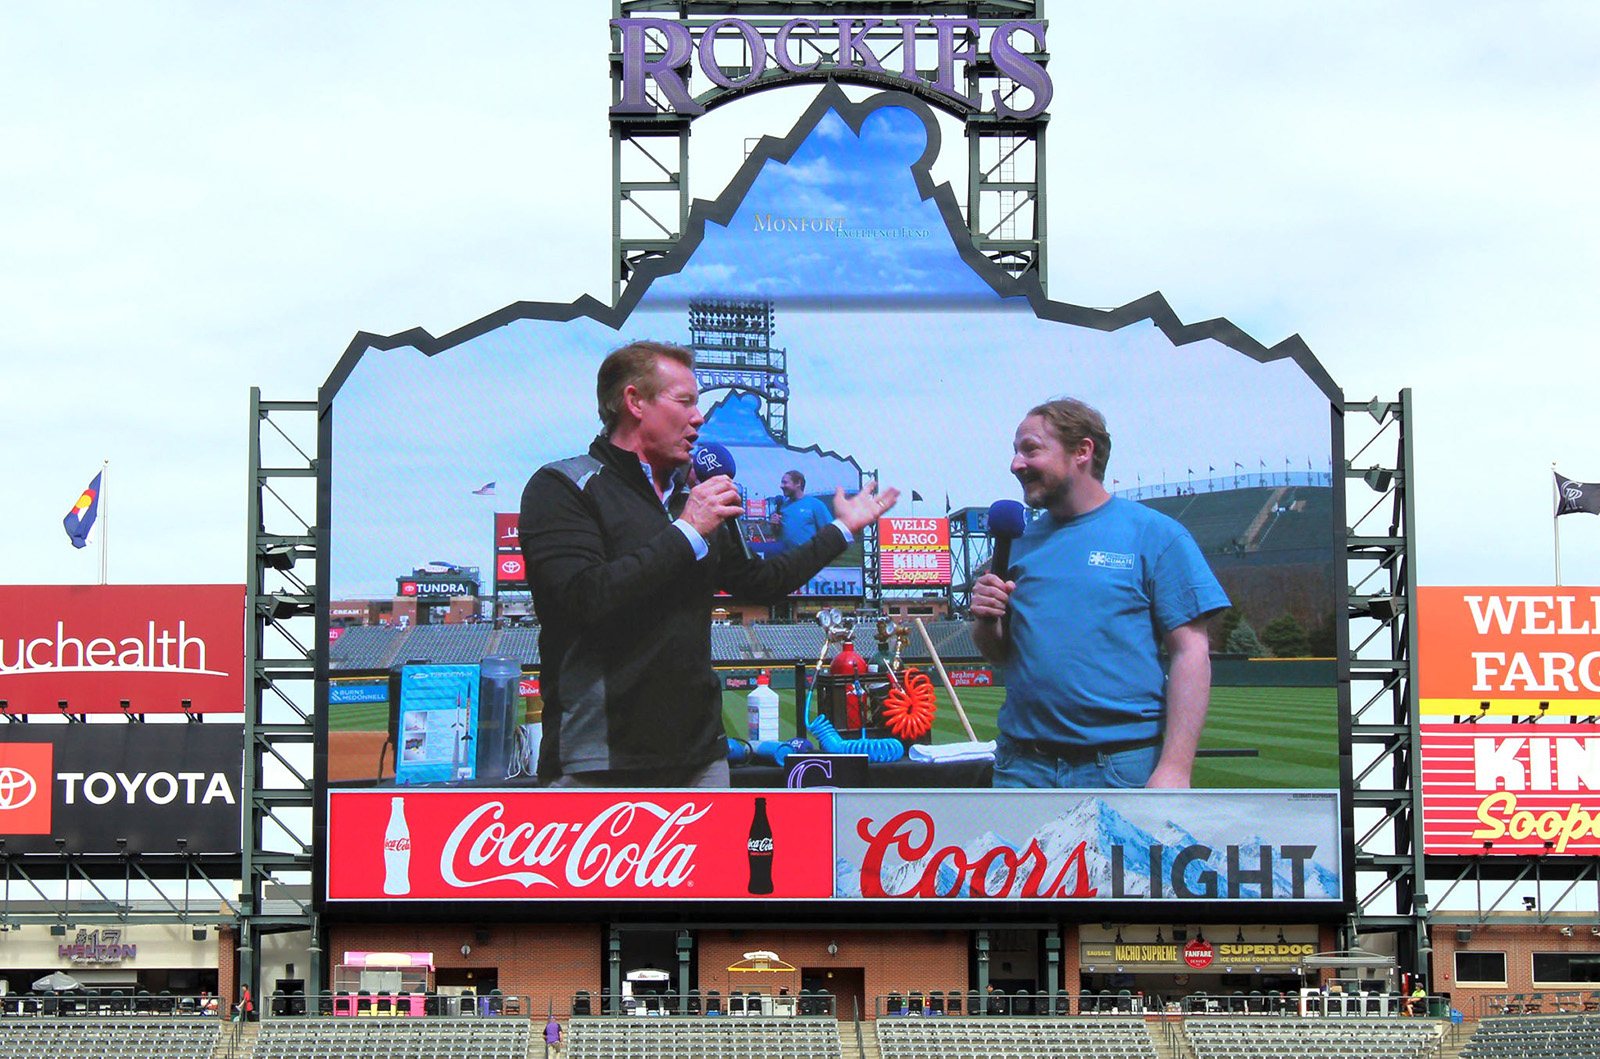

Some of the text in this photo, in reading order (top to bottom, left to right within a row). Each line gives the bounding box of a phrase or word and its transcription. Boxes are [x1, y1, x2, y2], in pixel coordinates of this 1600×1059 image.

[609, 18, 1054, 120] ROCKIES
[753, 213, 847, 232] MONFORT
[890, 519, 937, 531] WELLS
[892, 533, 938, 544] FARGO
[893, 554, 938, 568] KING
[893, 568, 939, 584] Soopers
[416, 583, 465, 594] TUNDRA
[805, 580, 857, 594] LIGHT
[1463, 595, 1600, 635] WEL
[0, 620, 207, 674] uchealth
[57, 771, 236, 805] TOYOTA
[440, 801, 713, 890] Coca-Cola
[856, 809, 1318, 899] Coors LIGHT
[58, 944, 137, 959] HELTON
[1115, 945, 1139, 961] NACHO
[1141, 945, 1177, 961] SUPREME
[1185, 950, 1212, 958] FANFARE
[1219, 944, 1314, 955] SUPER DOG
